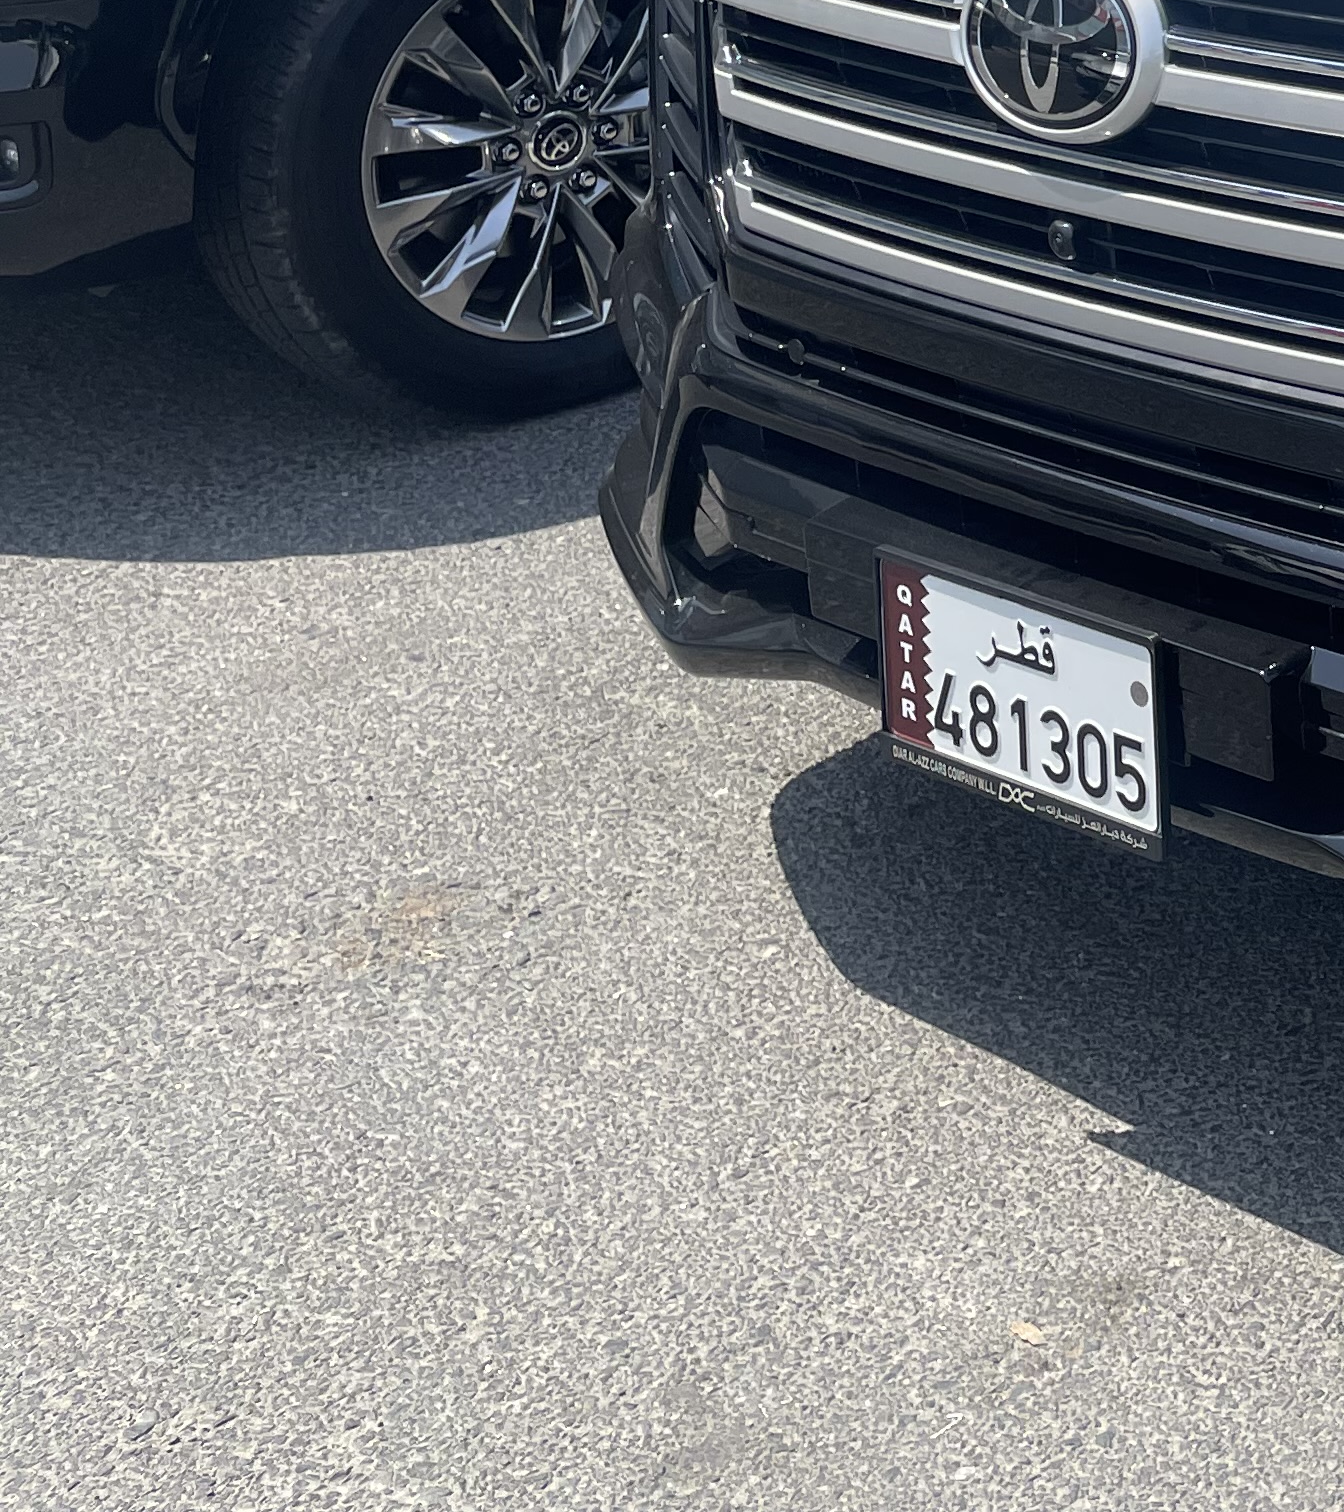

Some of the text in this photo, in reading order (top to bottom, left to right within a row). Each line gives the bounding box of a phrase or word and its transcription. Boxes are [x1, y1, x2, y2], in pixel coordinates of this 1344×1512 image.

[895, 583, 918, 723] QATAR
[976, 618, 1056, 676] قطر
[933, 669, 1148, 813] 481305
[947, 765, 978, 788] COMPANY
